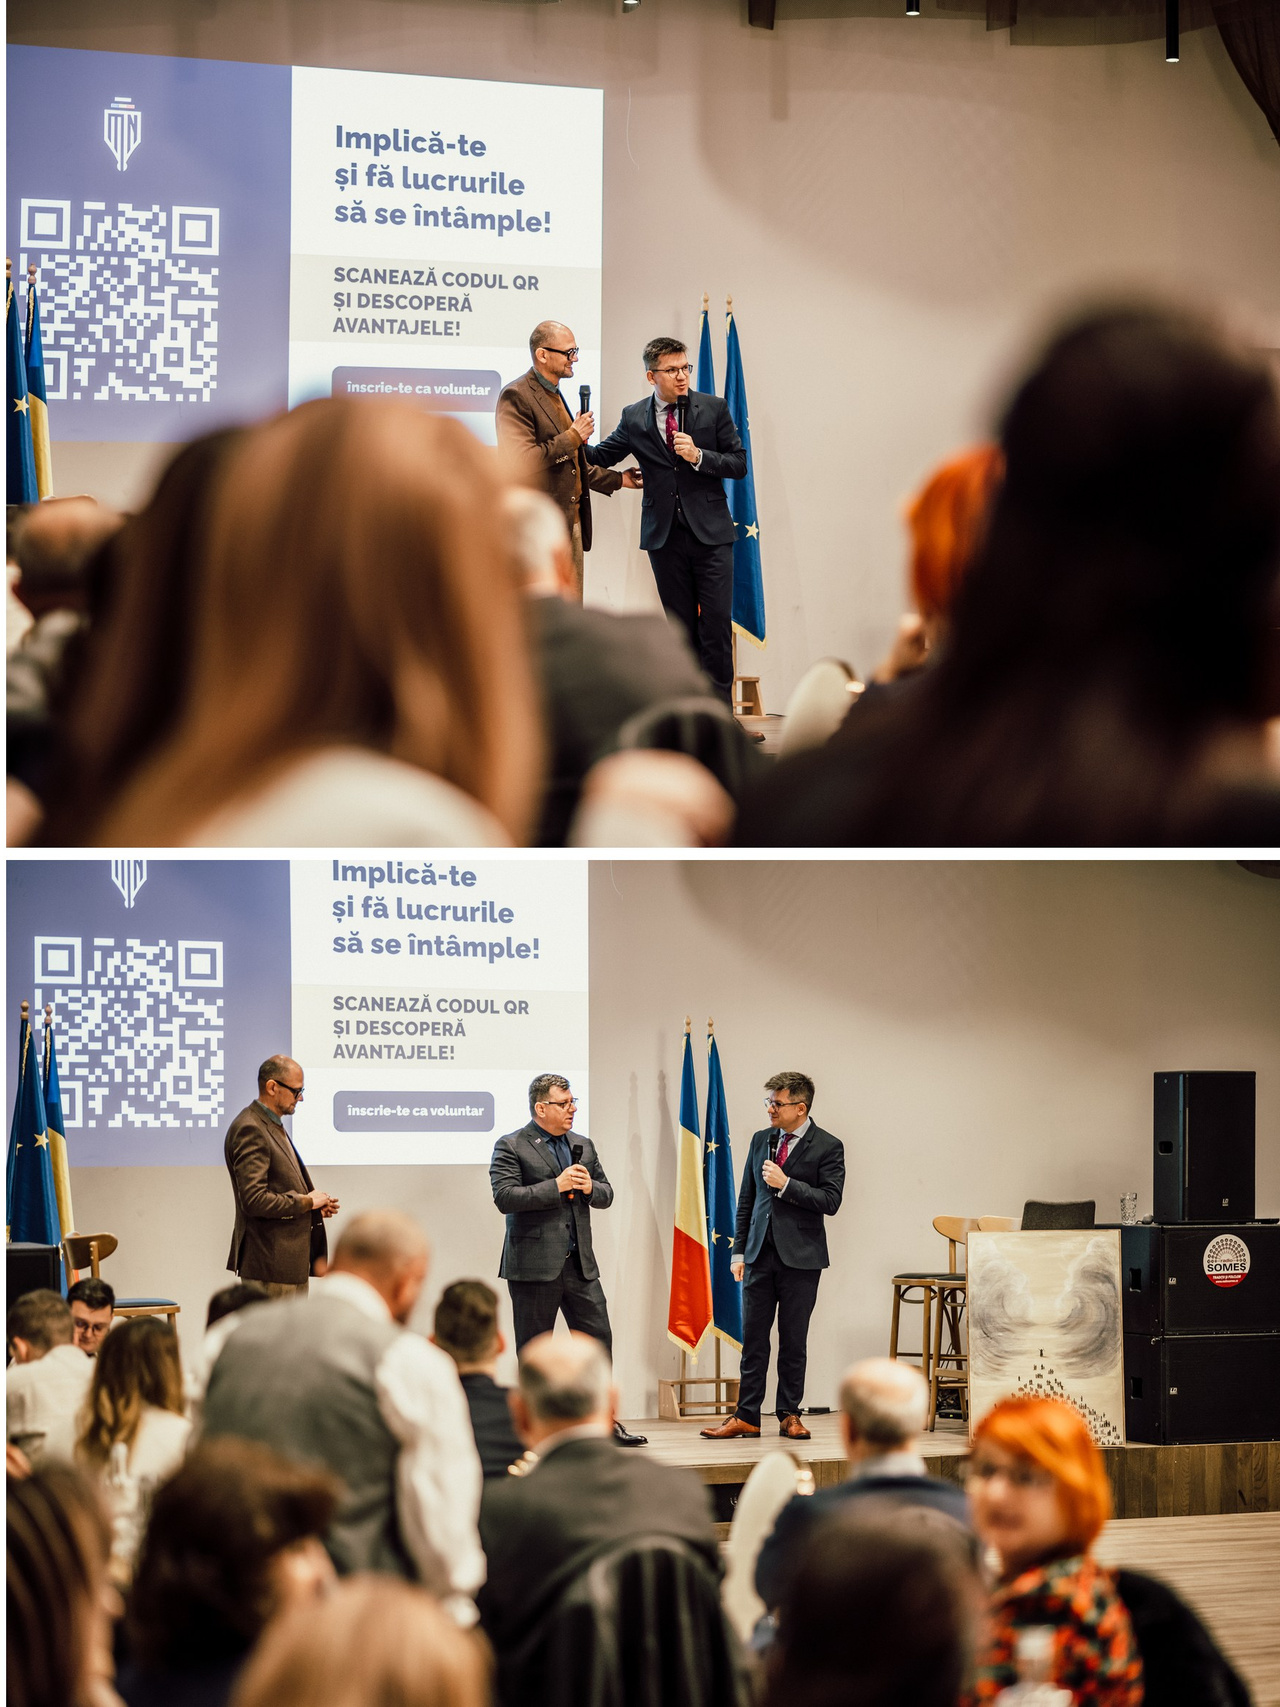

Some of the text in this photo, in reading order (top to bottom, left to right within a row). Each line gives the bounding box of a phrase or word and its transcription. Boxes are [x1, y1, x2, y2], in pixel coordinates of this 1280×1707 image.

[336, 124, 487, 158] Implică-te
[334, 162, 525, 196] și fă lucrurile
[334, 199, 551, 238] să se întâmple!
[333, 266, 540, 291] SCANEAZĂ CODUL QR
[333, 291, 473, 313] ȘI DESCOPERĂ
[332, 316, 461, 337] AVANTAJELE!
[346, 381, 491, 396] înscrie-te ca voluntar
[332, 860, 477, 889] Implică-te
[332, 894, 515, 924] și fă lucrurile
[332, 930, 539, 964] să se întâmple!
[333, 993, 530, 1015] SCANEAZĂ CODUL QR
[333, 1018, 467, 1039] ȘI DESCOPERĂ
[333, 1043, 455, 1060] AVANTAJELE!
[347, 1104, 485, 1117] înscrie-te ca voluntar
